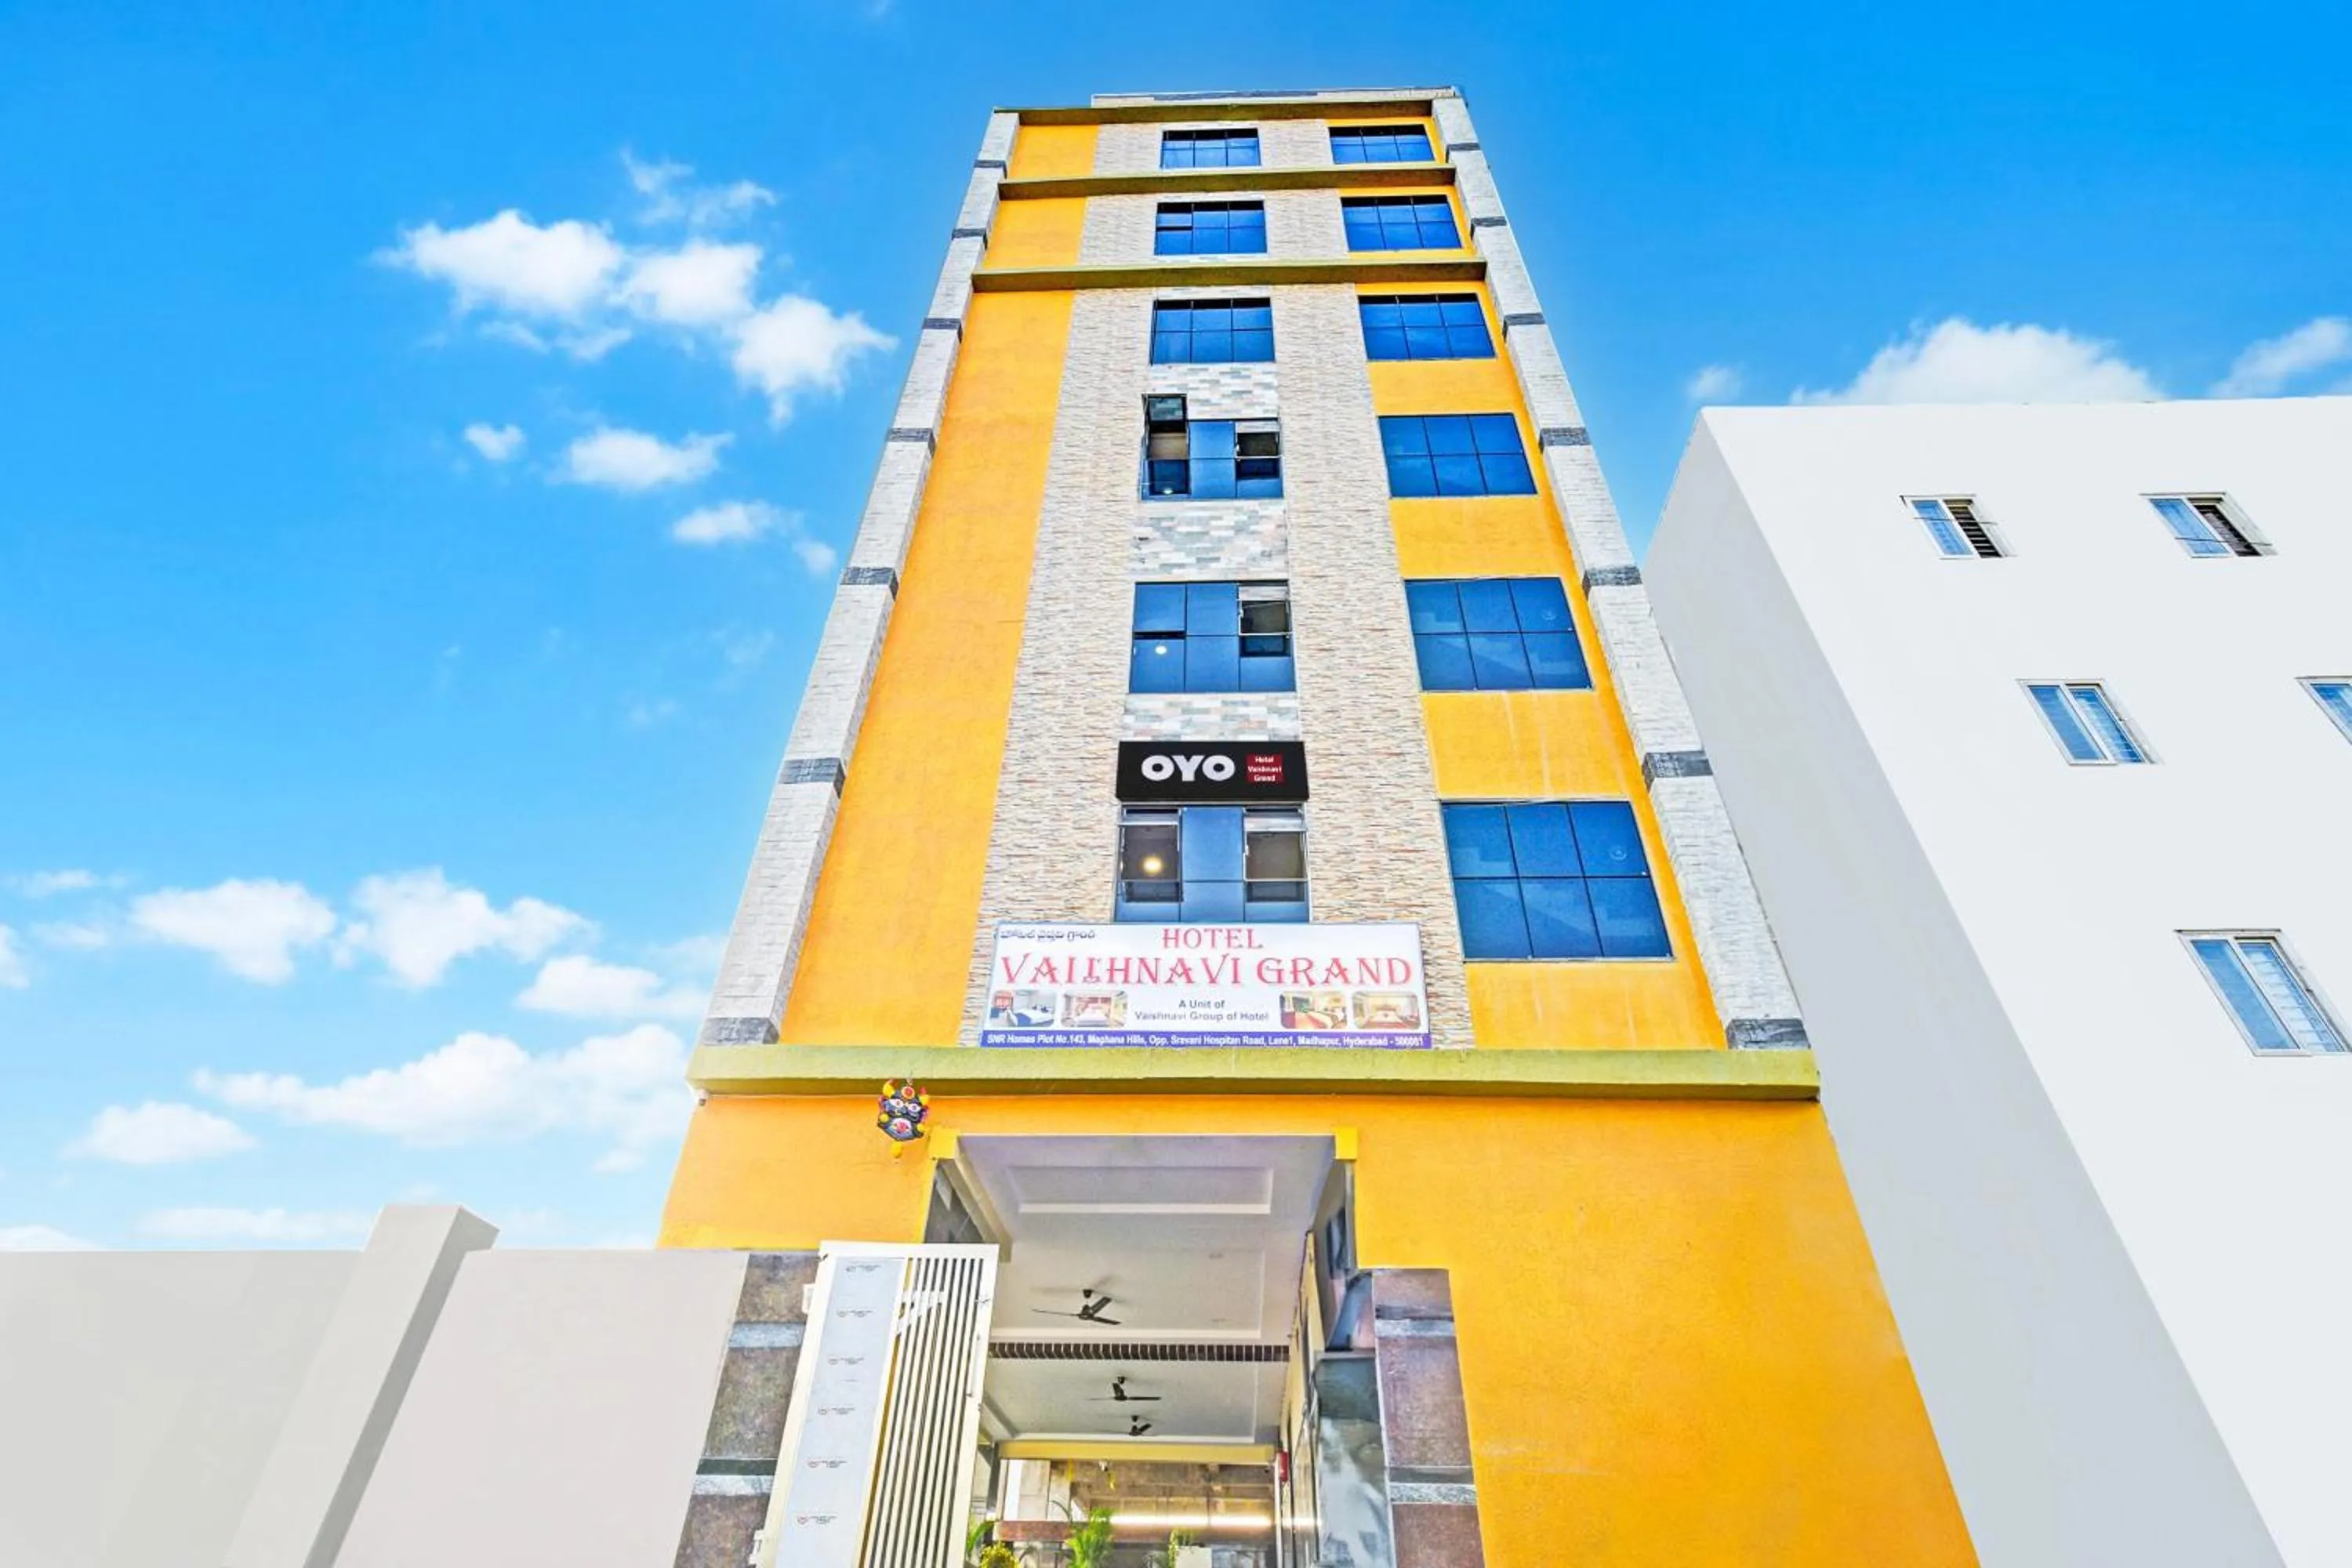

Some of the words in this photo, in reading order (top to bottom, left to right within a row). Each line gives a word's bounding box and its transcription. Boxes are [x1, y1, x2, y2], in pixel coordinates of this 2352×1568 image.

[1142, 755, 1236, 782] OYO
[1163, 927, 1264, 949] HOTEL
[1256, 955, 1412, 986] GRAND
[1178, 1000, 1186, 1009] A
[1189, 1000, 1211, 1009] Unit
[1214, 1000, 1225, 1009] of
[1134, 1011, 1186, 1021] Vaishnavi
[1189, 1011, 1224, 1022] Group
[1226, 1011, 1238, 1021] of
[1240, 1011, 1269, 1021] Hotel
[1037, 1034, 1054, 1044] Plot
